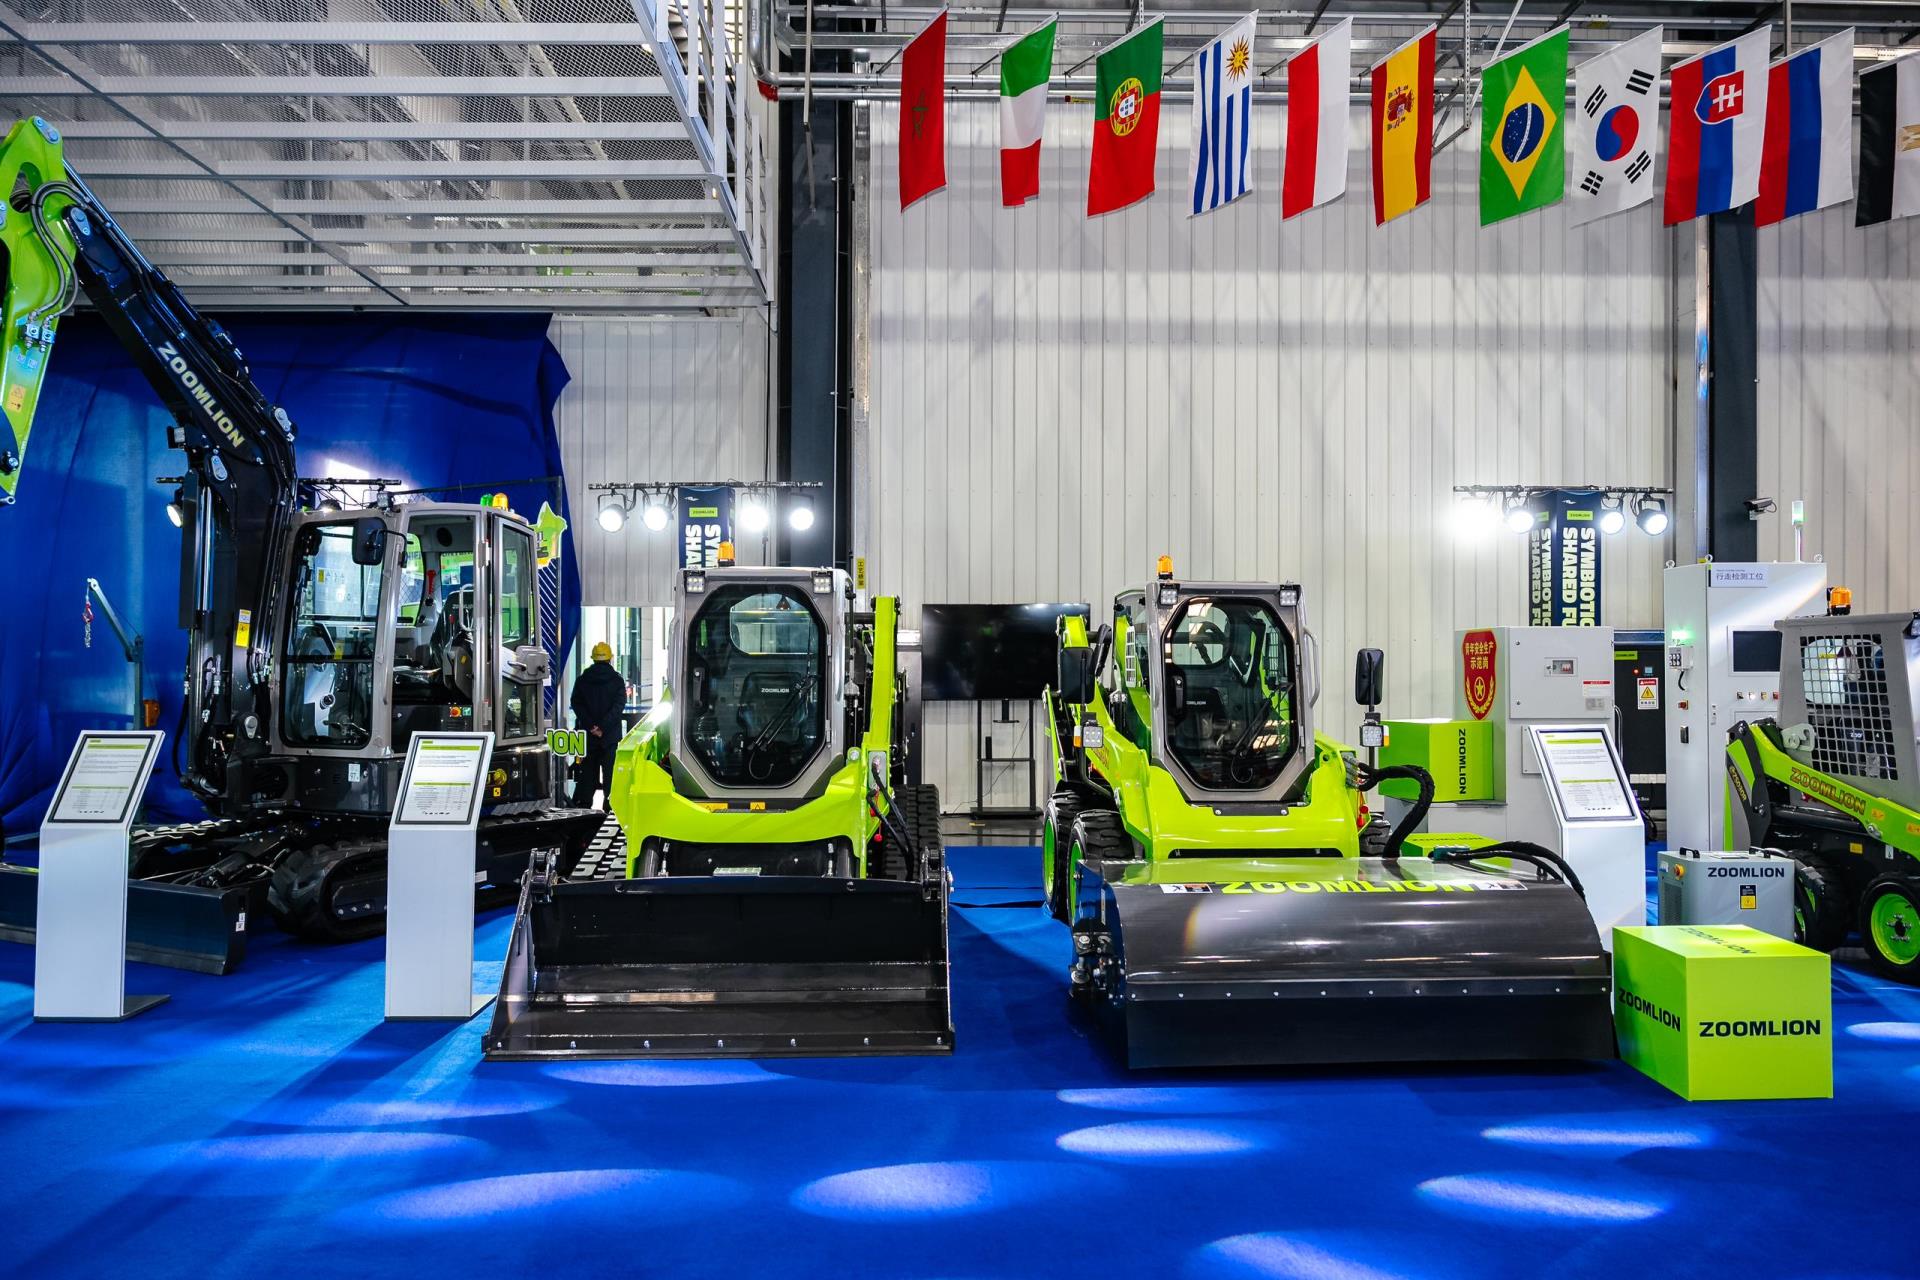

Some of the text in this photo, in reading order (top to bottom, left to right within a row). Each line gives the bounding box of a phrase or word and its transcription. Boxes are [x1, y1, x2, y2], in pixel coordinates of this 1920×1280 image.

[158, 341, 245, 448] ZOOMLION
[685, 525, 702, 569] SHA
[705, 525, 721, 568] SYM
[1562, 527, 1578, 603] SHARED
[1580, 527, 1595, 627] SYMBIOTIC
[1716, 572, 1763, 581] 行走检测工位
[1465, 641, 1494, 655] 青年安全生产
[1470, 656, 1489, 670] 示范岗
[1790, 767, 1866, 815] ZOOMLION
[1216, 880, 1475, 894] ZOOMLION
[1707, 867, 1785, 878] ZOOMLION
[1618, 987, 1681, 1032] ZOOMLION
[1699, 1019, 1821, 1038] ZOOMLION
